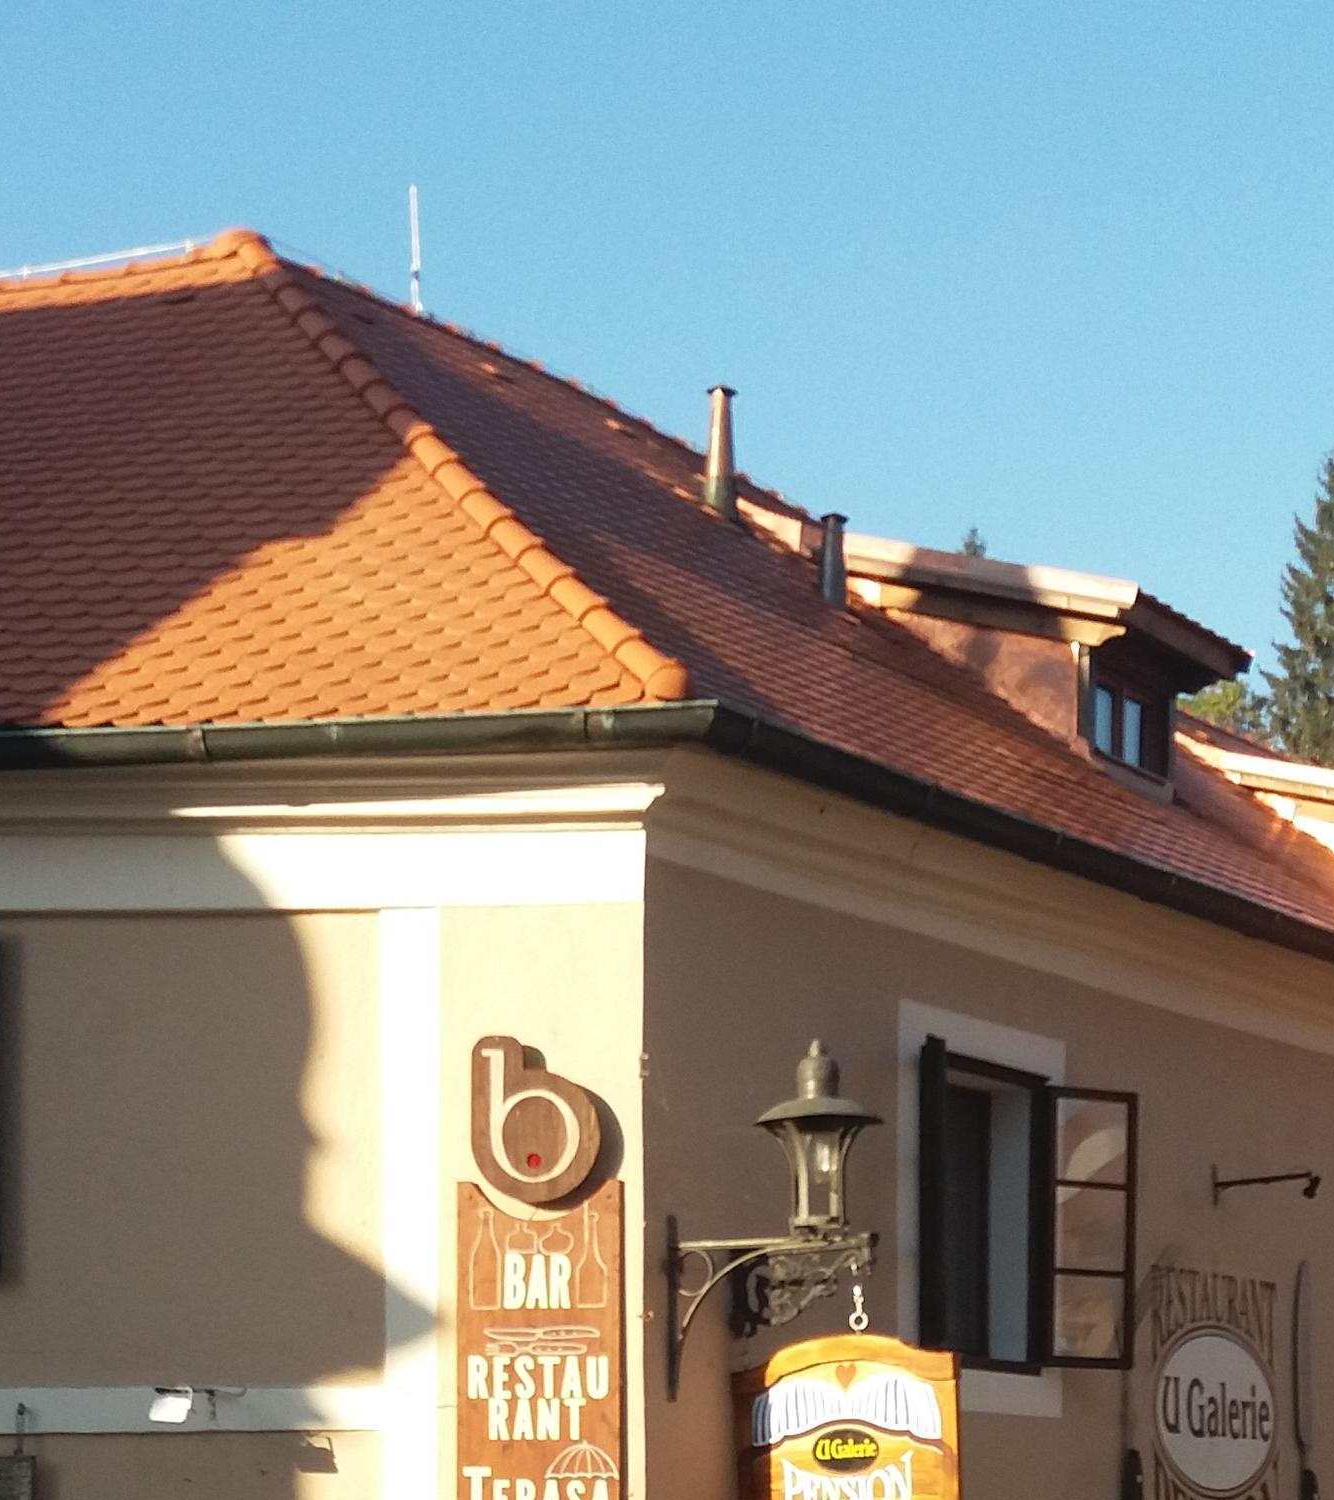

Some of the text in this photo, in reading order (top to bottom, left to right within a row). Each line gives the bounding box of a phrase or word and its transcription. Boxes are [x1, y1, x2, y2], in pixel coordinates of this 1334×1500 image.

[503, 1252, 572, 1310] BAR
[467, 1354, 610, 1400] RESTAU
[487, 1398, 587, 1441] RANT
[1162, 1375, 1271, 1442] U Galerie
[815, 1438, 832, 1461] U
